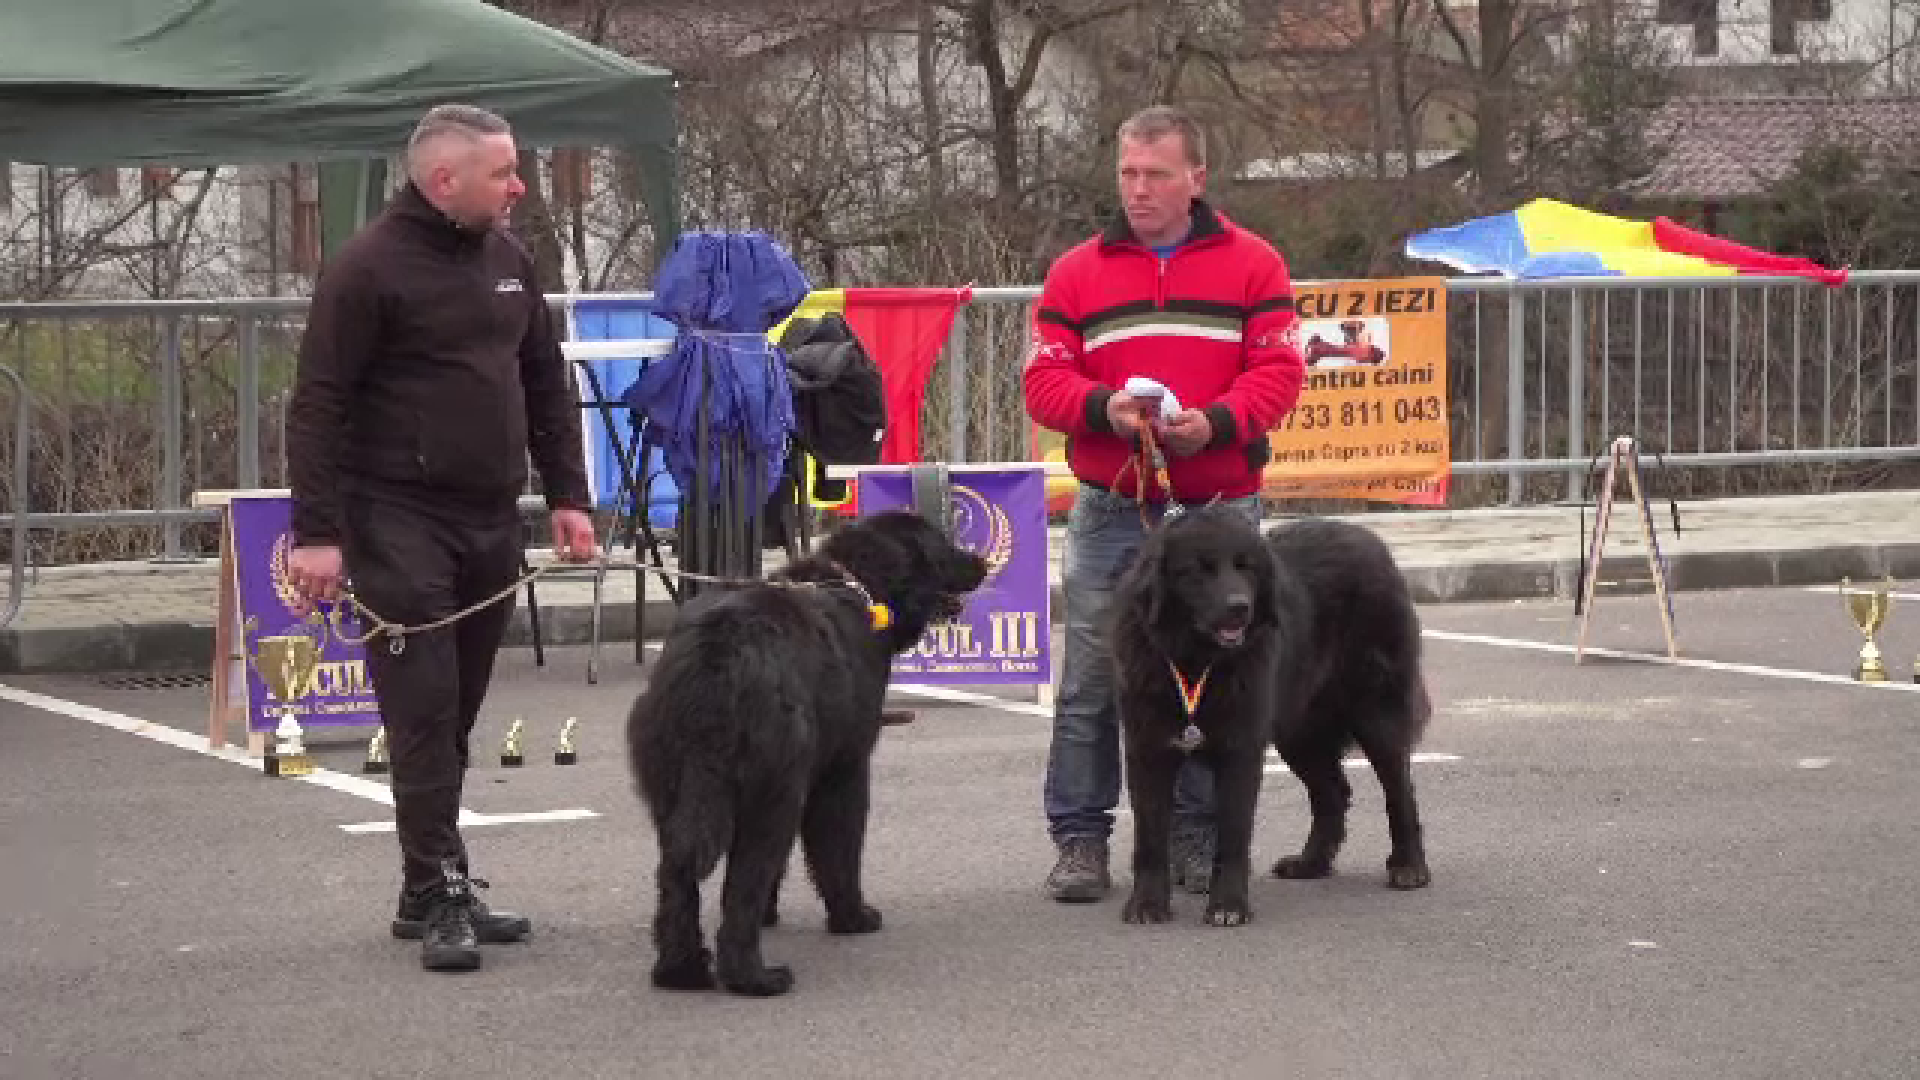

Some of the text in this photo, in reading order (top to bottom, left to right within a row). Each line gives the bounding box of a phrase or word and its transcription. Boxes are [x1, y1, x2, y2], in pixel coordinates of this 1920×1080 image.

[1296, 287, 1436, 318] CU 2 IEZI
[1340, 400, 1384, 427] 811
[1394, 395, 1442, 424] 043
[989, 611, 1039, 658] III
